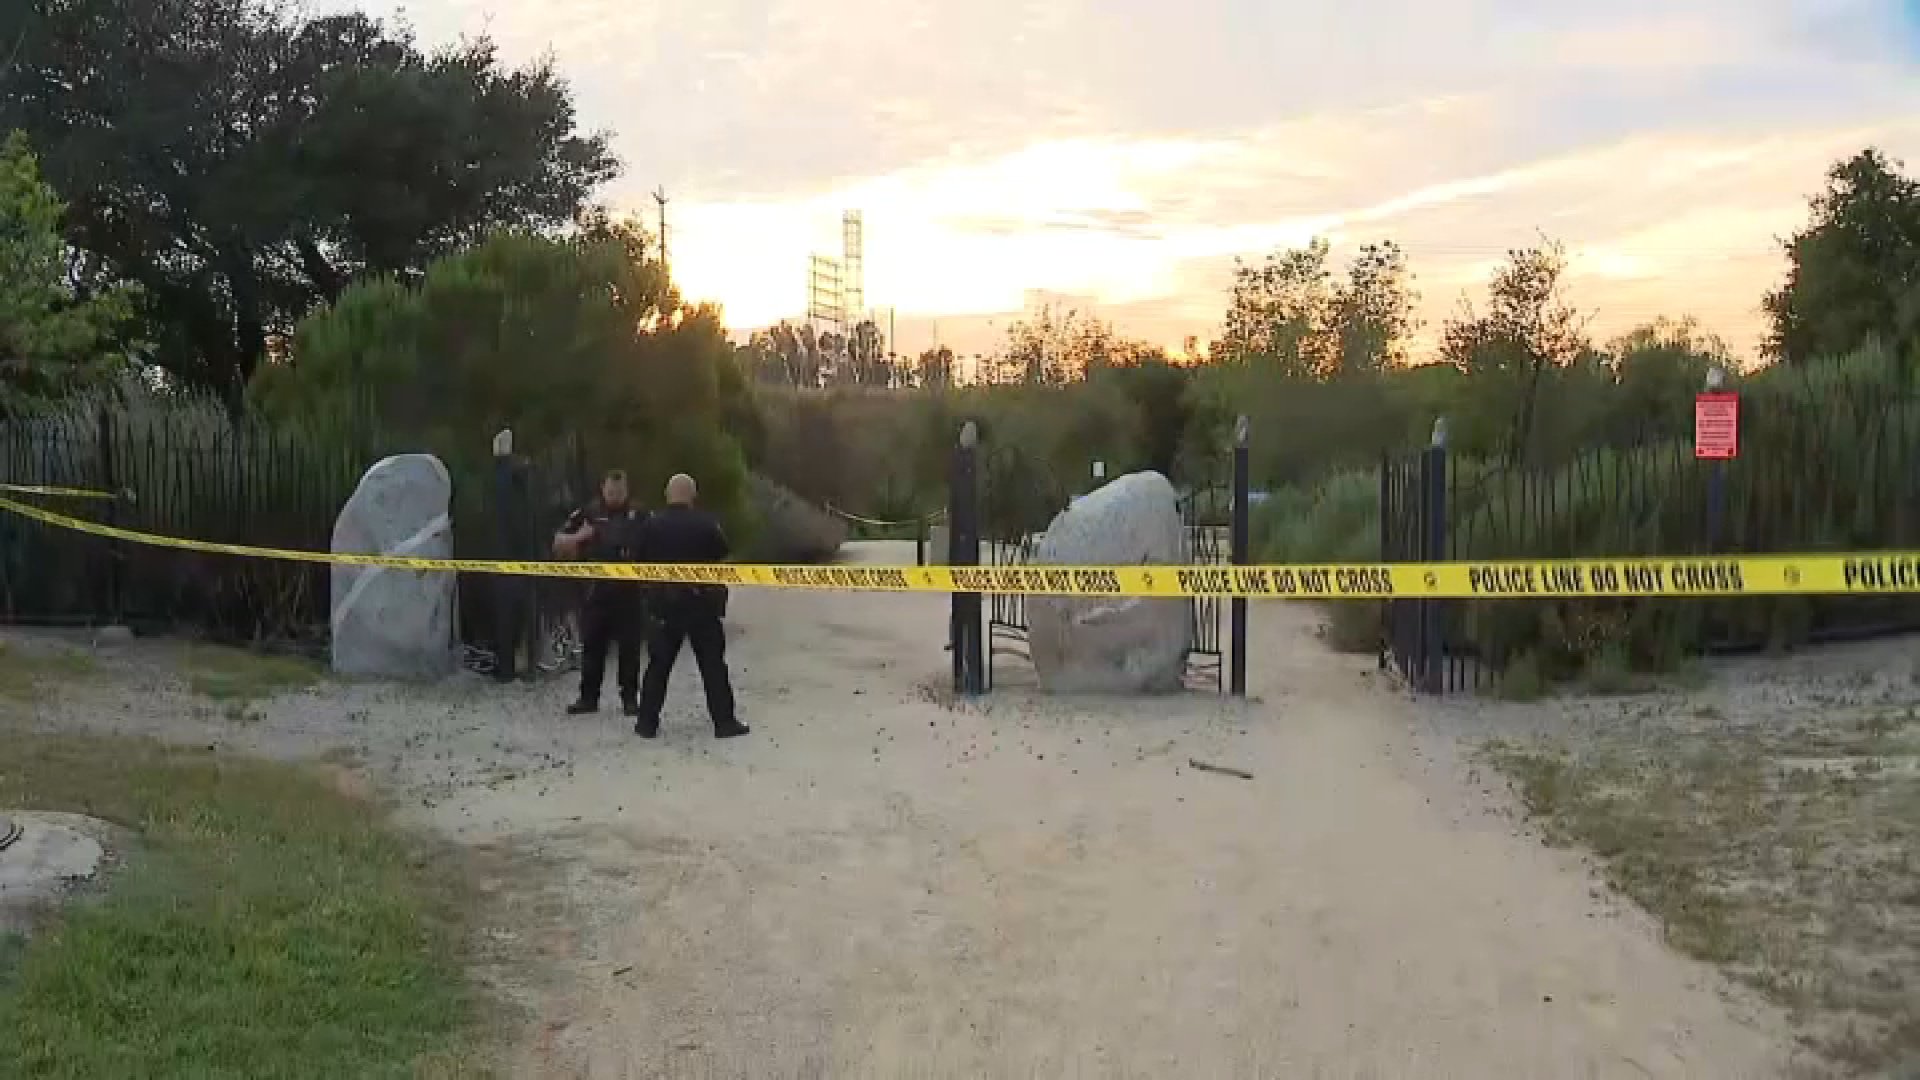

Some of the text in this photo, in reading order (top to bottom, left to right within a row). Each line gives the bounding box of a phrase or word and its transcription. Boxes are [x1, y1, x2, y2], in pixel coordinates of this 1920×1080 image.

[951, 570, 996, 590] POLICE
[1074, 570, 1121, 592] CROSS
[1176, 568, 1393, 593] POLICE LINE DO NOT CROSS
[1469, 563, 1744, 593] POLICE LINE DO NOT CROSS
[1844, 557, 1920, 589] POLIC
